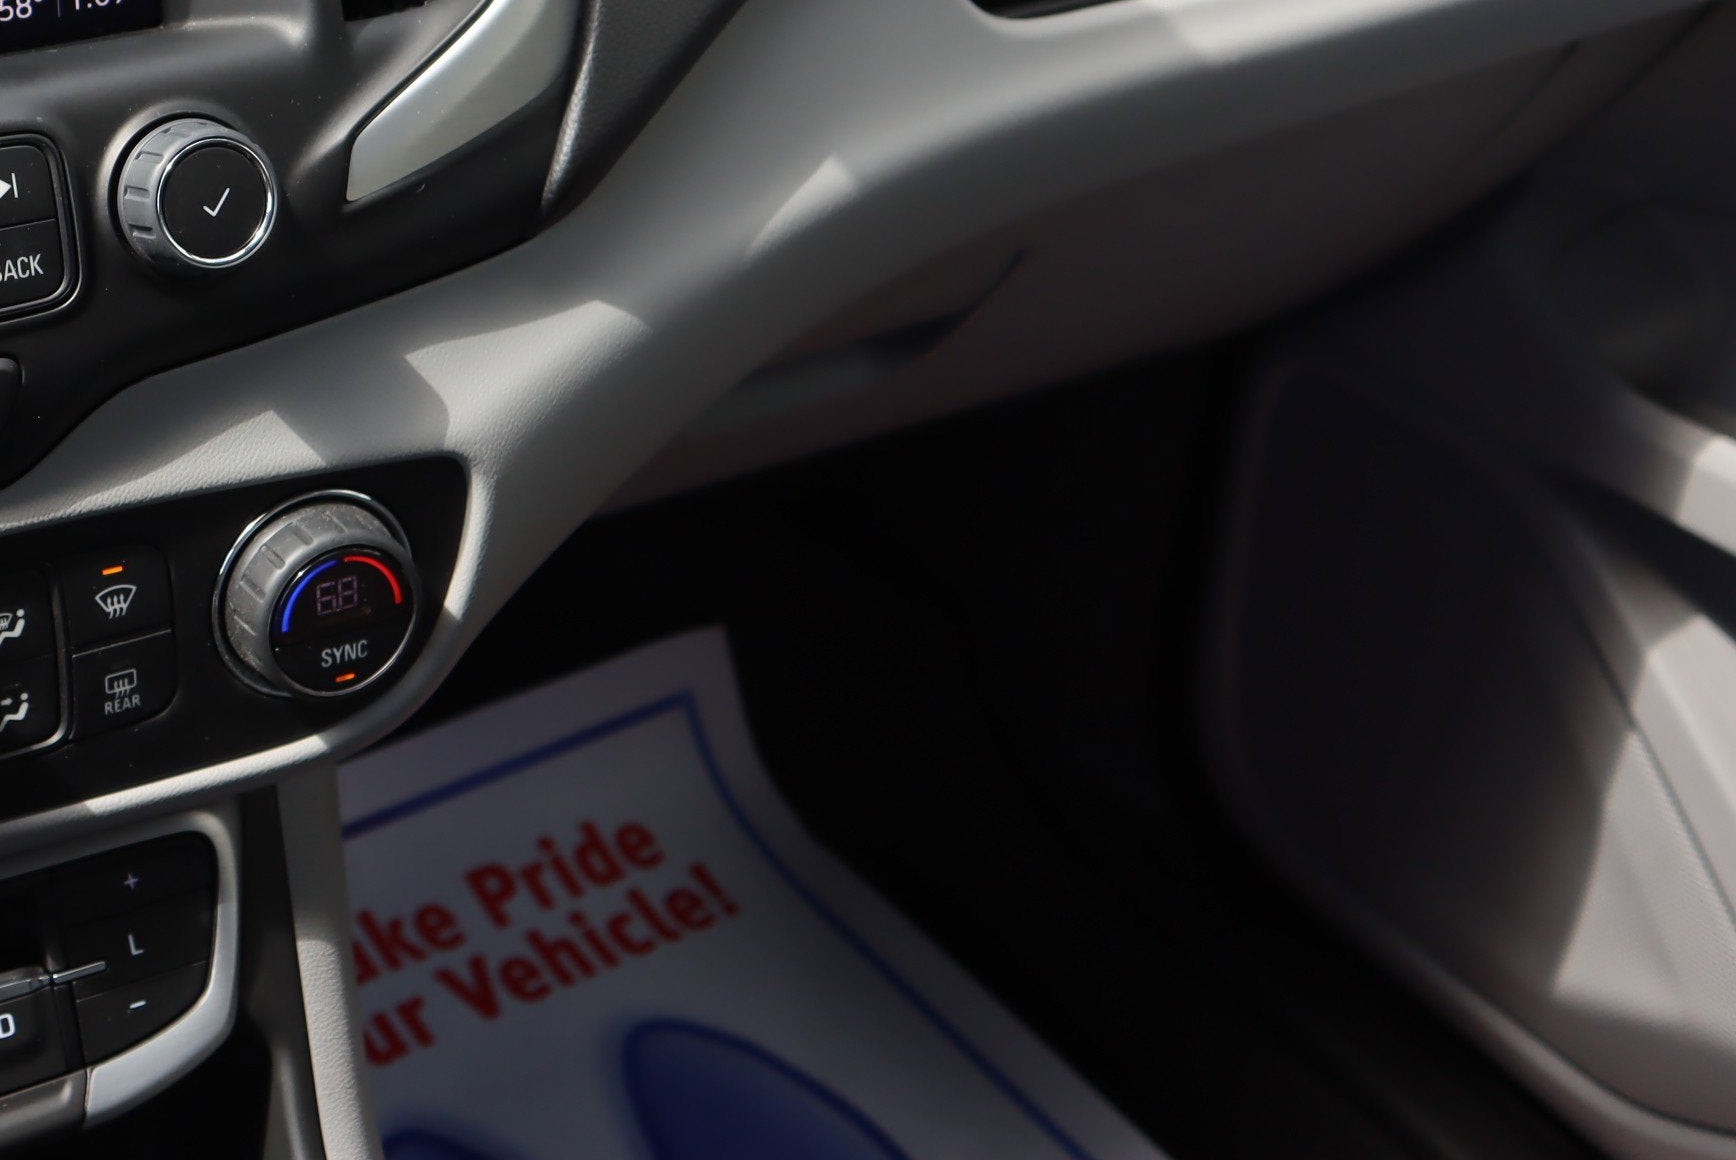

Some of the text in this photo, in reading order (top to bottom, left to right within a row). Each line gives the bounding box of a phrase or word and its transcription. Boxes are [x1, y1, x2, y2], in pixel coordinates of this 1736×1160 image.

[316, 576, 358, 616] 68
[321, 640, 368, 667] SYNC
[104, 693, 141, 715] REAR
[465, 819, 665, 930] Pride
[128, 934, 144, 956] L
[364, 862, 740, 1066] ur Vehicle!
